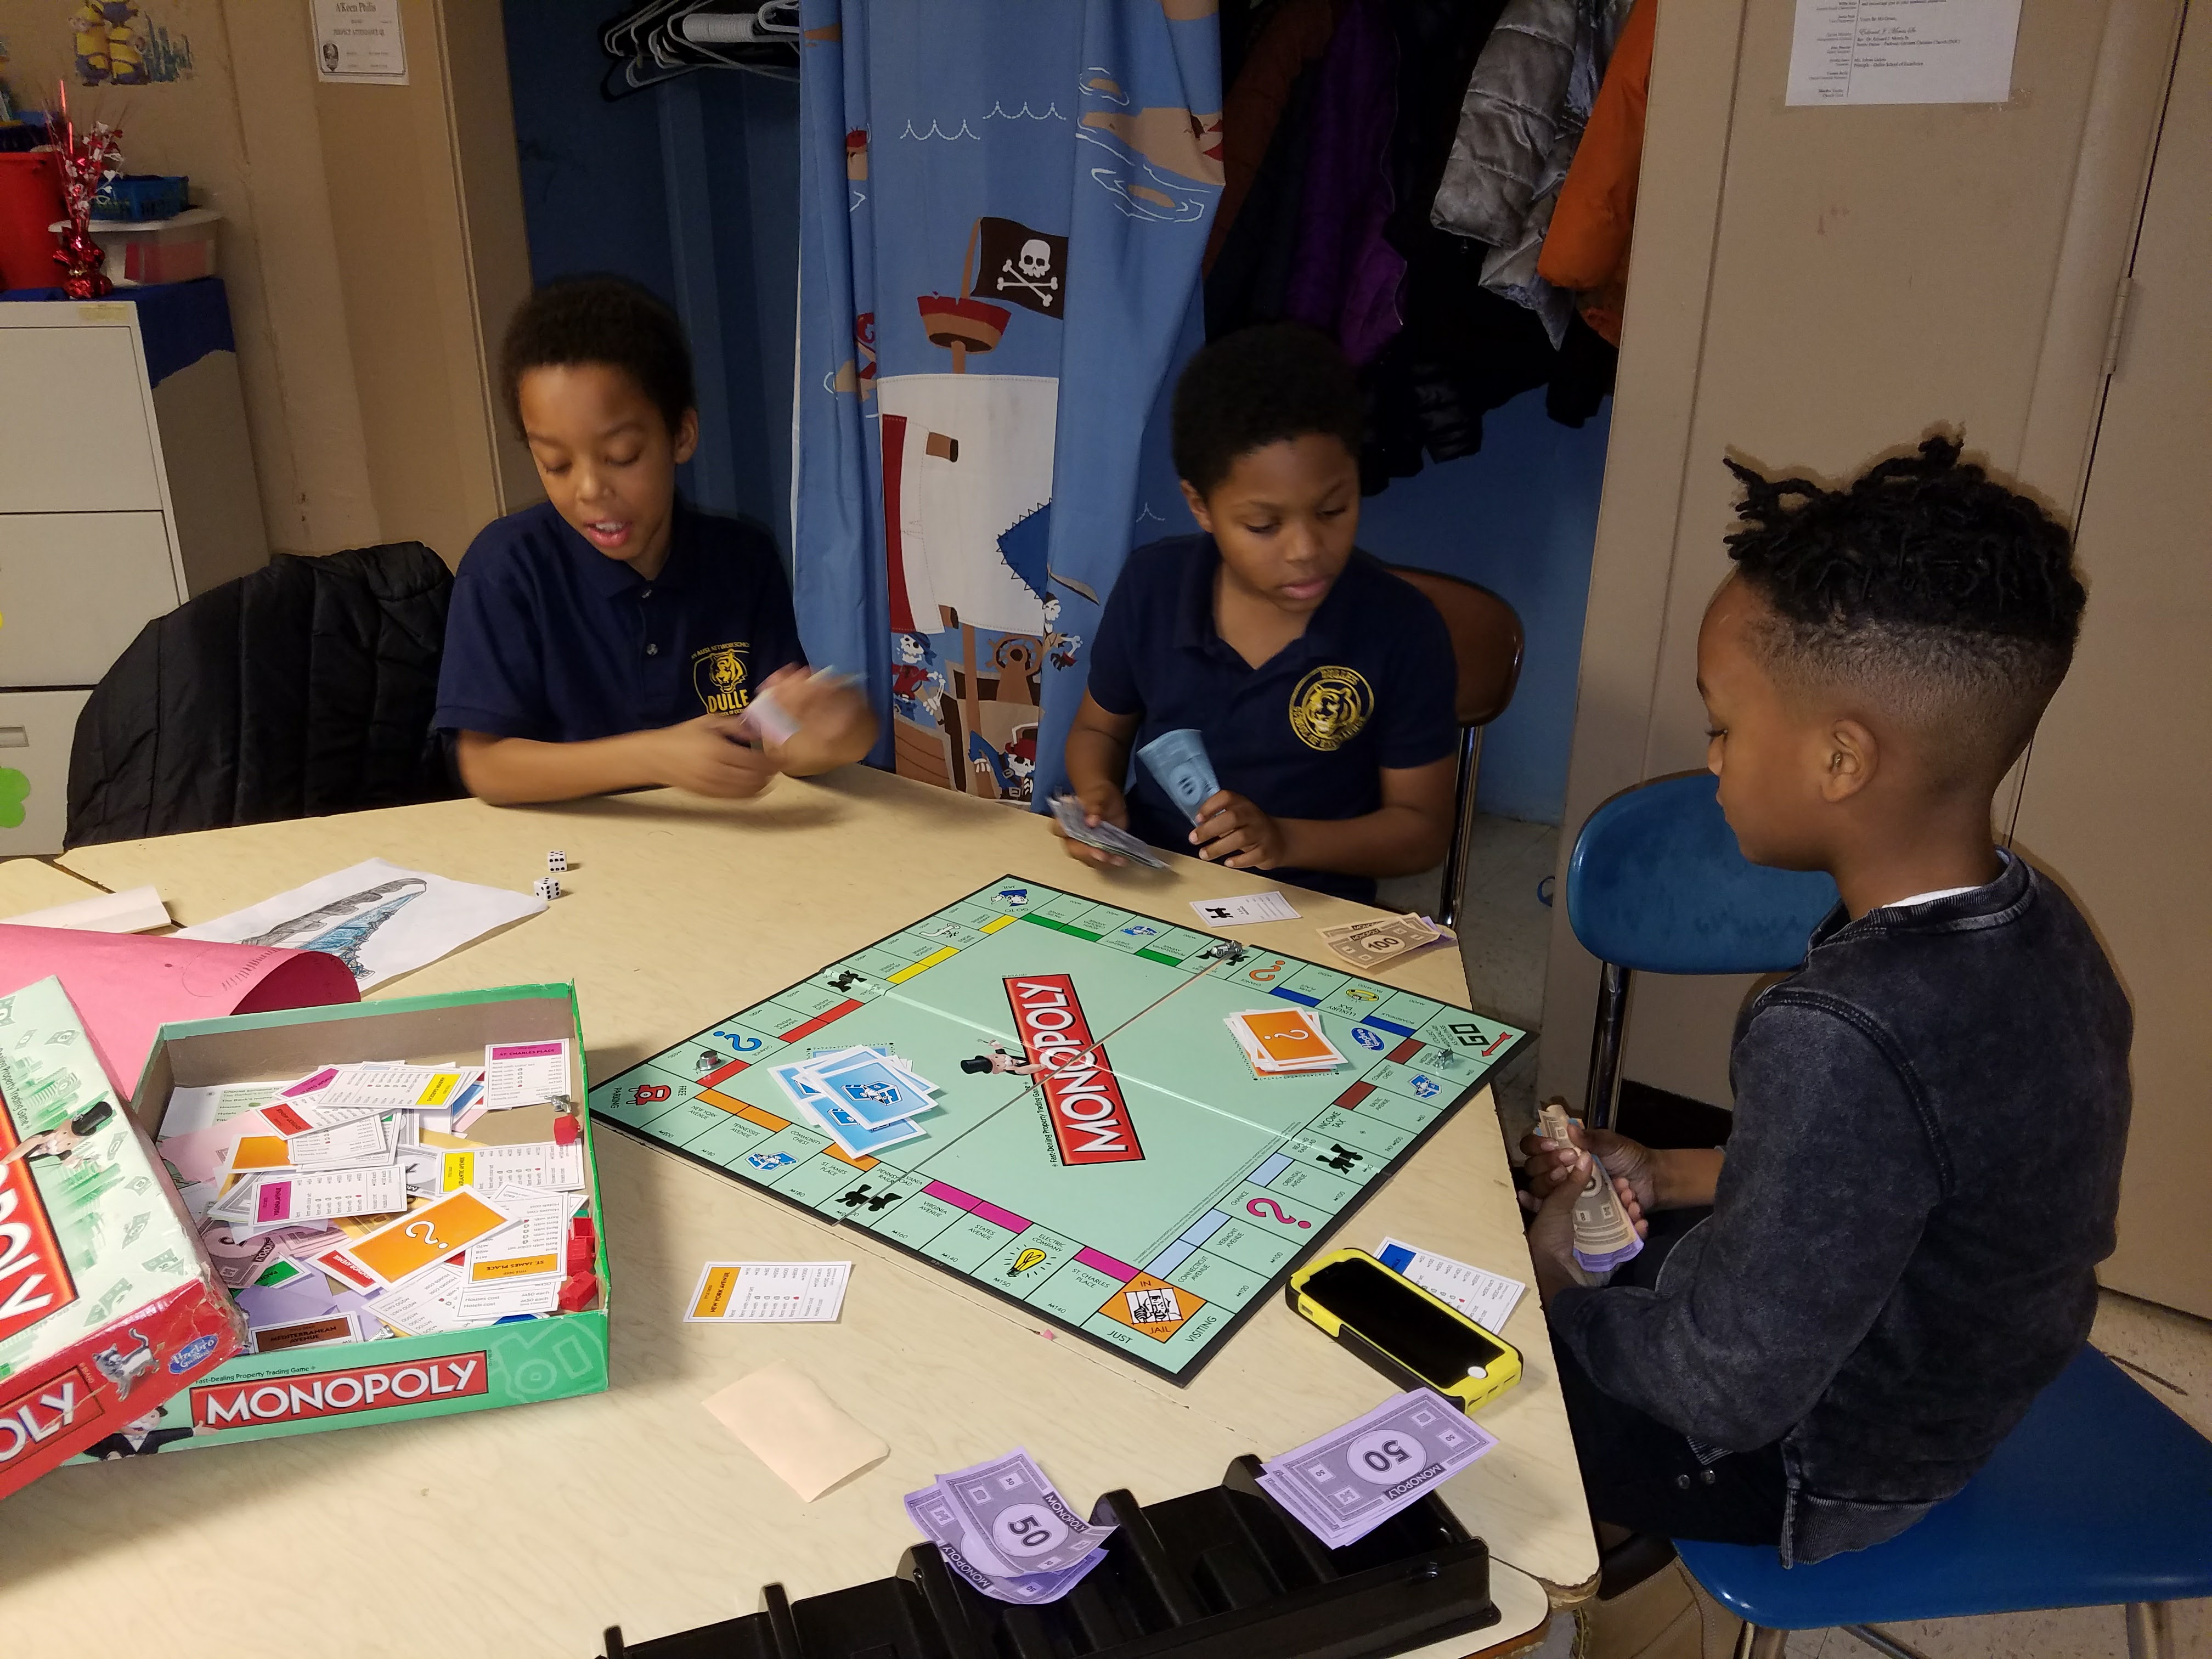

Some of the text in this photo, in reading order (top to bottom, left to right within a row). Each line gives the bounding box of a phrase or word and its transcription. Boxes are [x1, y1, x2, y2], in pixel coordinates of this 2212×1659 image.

[1351, 928, 1379, 940] MONOPOLY
[1368, 938, 1399, 950] 100
[1241, 979, 1261, 987] CHANCE
[1327, 1005, 1357, 1017] LUXURY
[1448, 1024, 1491, 1046] GO
[752, 1045, 772, 1057] CHANCE
[1016, 981, 1128, 1153] MONOPOLY
[1, 1066, 29, 1126] Property Trading Game
[611, 1087, 622, 1109] PARKING
[678, 1086, 687, 1096] FREE
[687, 1110, 709, 1120] AVENUE
[1317, 1111, 1341, 1130] INCOME
[733, 1123, 760, 1136] TENNESSEE
[1035, 1098, 1057, 1163] Fast-Dealing Property Trading
[1331, 1119, 1346, 1128] TAX
[730, 1128, 752, 1138] AVENUE
[790, 1130, 822, 1145] COMMUNITY
[792, 1137, 810, 1146] CHEST
[820, 1167, 838, 1176] PLACE
[828, 1164, 848, 1175] JAMES
[1282, 1170, 1302, 1187] ORIENTAL
[1290, 1173, 1307, 1188] AVENUE
[1231, 1190, 1249, 1206] CHANCE
[918, 1205, 943, 1218] AVENUE
[923, 1201, 948, 1215] VIRGINIA
[967, 1227, 993, 1241] AVENUE
[974, 1224, 996, 1236] STATES
[1216, 1227, 1239, 1246] VERMONT
[1032, 1237, 1064, 1252] COMPANY
[1039, 1234, 1066, 1248] ELECTRIC
[1226, 1232, 1244, 1248] AVENUE
[1177, 1255, 1208, 1283] CONNECTICUT
[1192, 1263, 1210, 1282] AVENUE
[434, 1273, 450, 1284] Hotels
[438, 1277, 458, 1289] Houses
[1075, 1277, 1096, 1288] PLACE
[1081, 1273, 1110, 1288] CHARLES
[714, 1289, 724, 1302] YORK
[721, 1272, 730, 1289] AVENUE
[390, 1308, 402, 1316] each
[270, 1327, 337, 1341] MEDITERRANEAN
[1150, 1325, 1172, 1334] JAIL
[1184, 1315, 1217, 1344] VISITING
[289, 1334, 320, 1344] AVENUE
[1106, 1330, 1133, 1344] JUST
[171, 1339, 216, 1364] Hasbro
[236, 1371, 264, 1379] Property
[207, 1359, 478, 1425] MONOPOLY
[1444, 1434, 1455, 1442] 50
[1363, 1440, 1413, 1473] 50
[1315, 1470, 1326, 1478] 50
[1005, 1478, 1015, 1486] 50
[1386, 1464, 1442, 1499] MONOPOLY
[1045, 1496, 1087, 1532] MONOPOLY
[1007, 1514, 1052, 1547] 50
[942, 1545, 990, 1588] MONOPOLY
